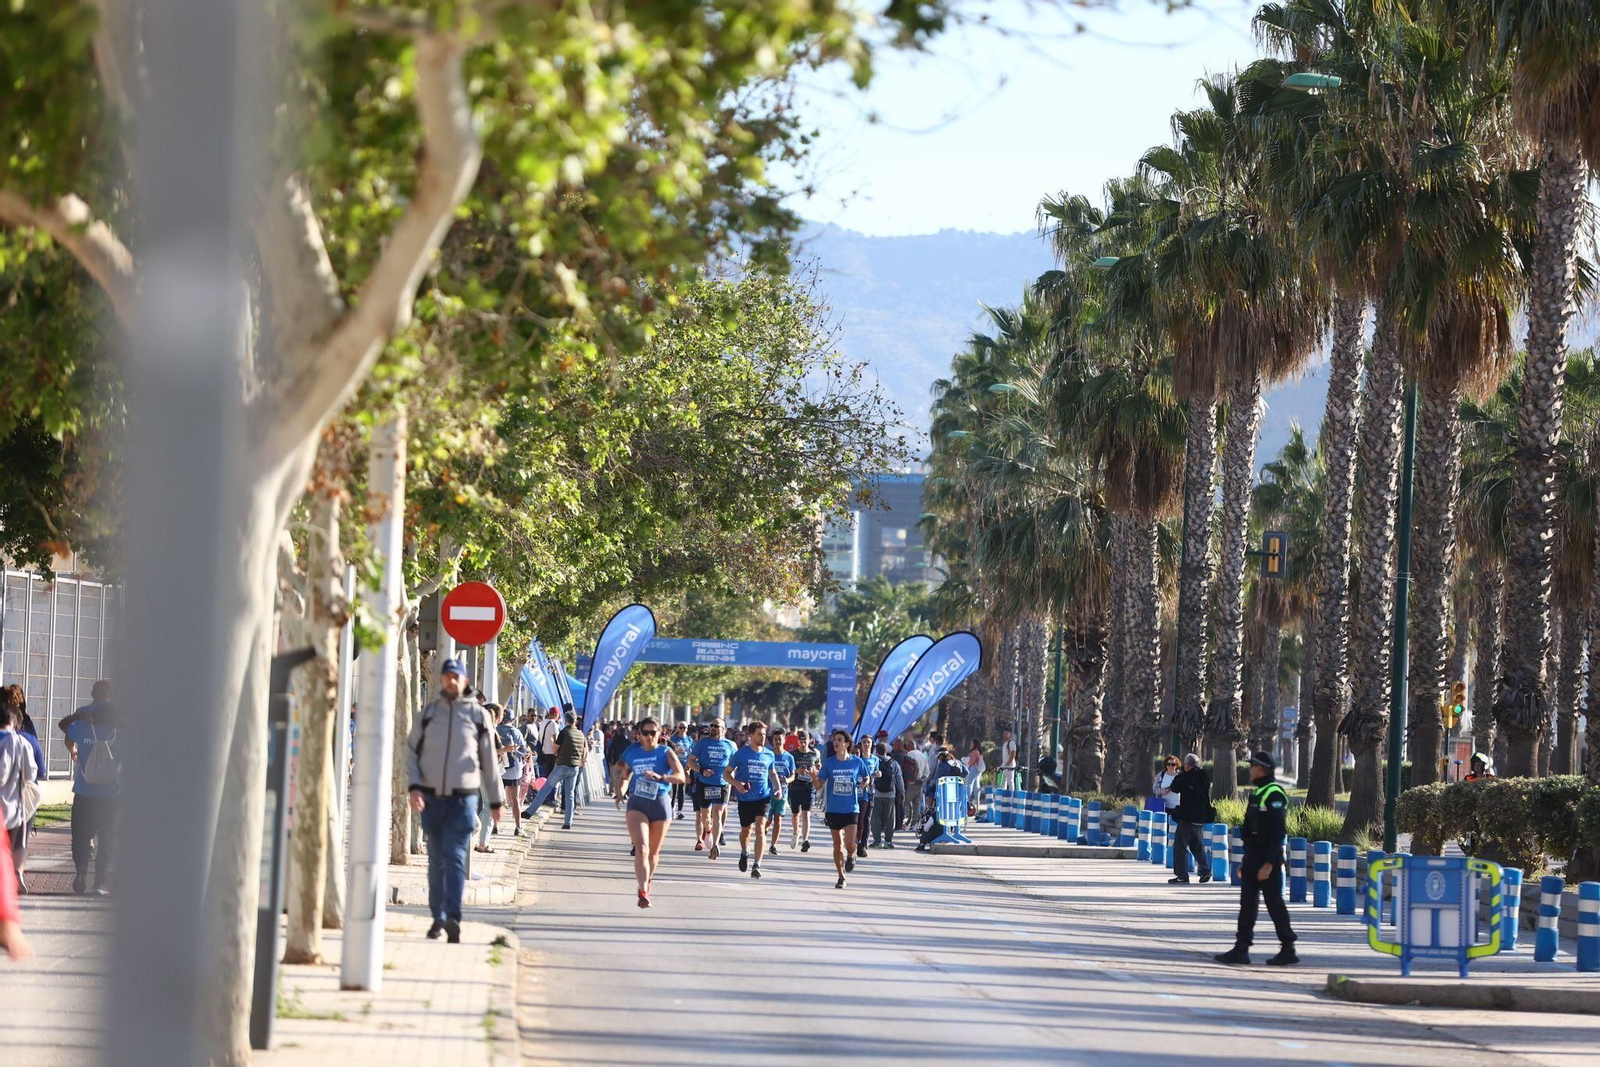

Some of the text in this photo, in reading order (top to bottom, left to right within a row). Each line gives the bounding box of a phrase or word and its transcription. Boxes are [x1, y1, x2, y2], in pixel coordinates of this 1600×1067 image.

[594, 622, 641, 693] mayoral
[695, 654, 736, 662] FRIENDS
[787, 648, 847, 663] mayoral
[900, 650, 966, 715] mayoral
